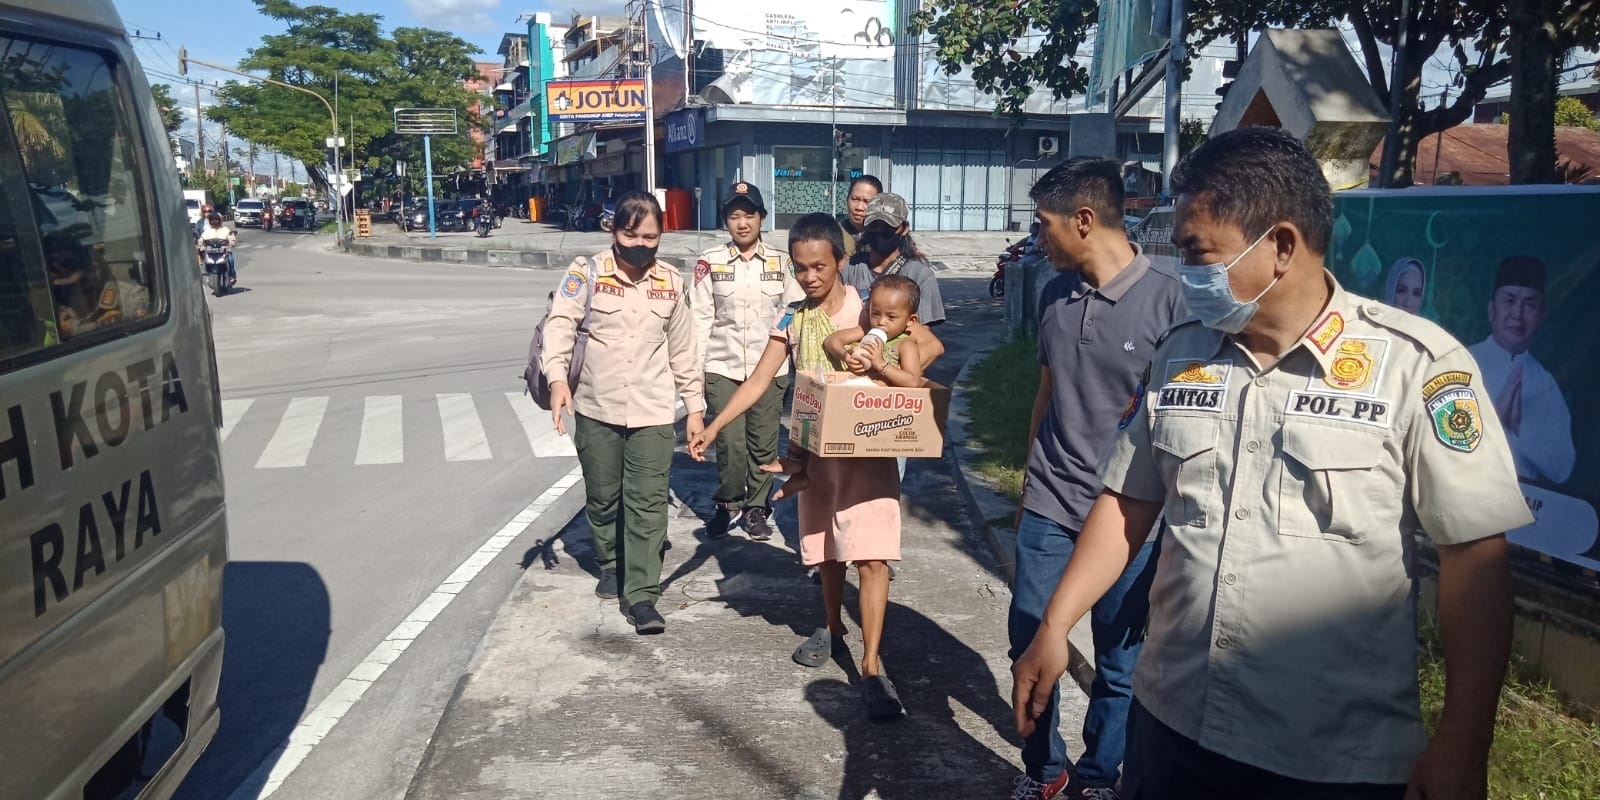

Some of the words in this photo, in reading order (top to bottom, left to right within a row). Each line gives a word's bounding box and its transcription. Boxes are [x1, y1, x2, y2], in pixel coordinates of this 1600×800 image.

[576, 90, 645, 109] JOTUN
[49, 351, 189, 471] KOTA
[796, 386, 810, 405] Good
[810, 393, 822, 413] Day
[854, 391, 893, 409] Good
[894, 393, 924, 414] Day
[1294, 394, 1342, 416] POL
[1351, 401, 1387, 422] PP
[854, 414, 914, 437] Cappuccino
[30, 469, 162, 618] RAYA
